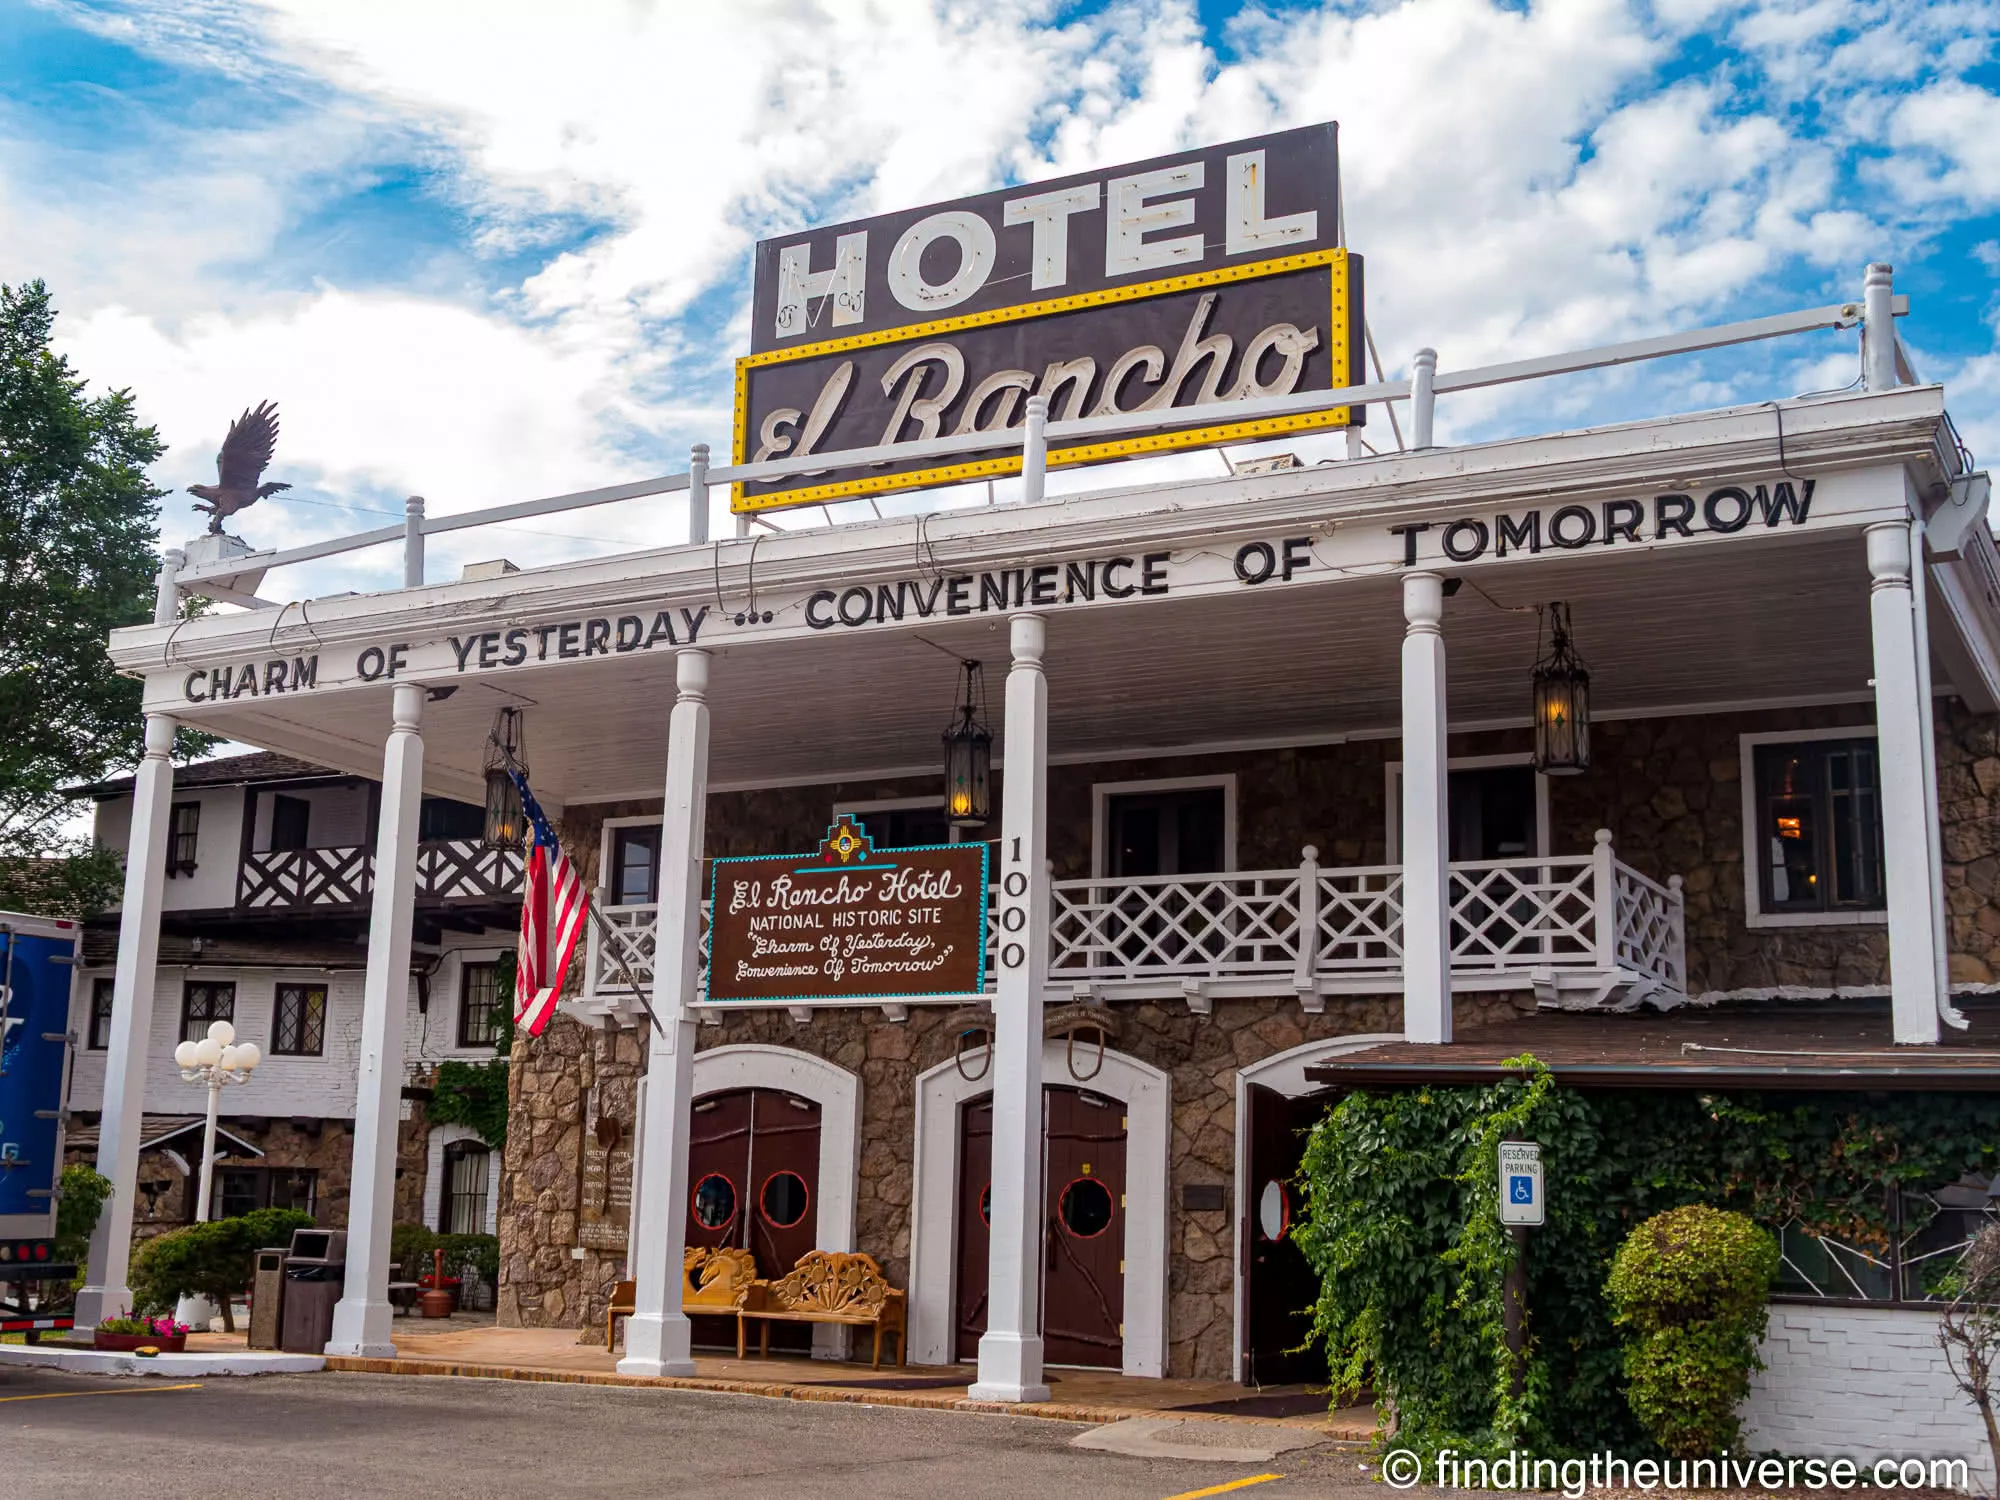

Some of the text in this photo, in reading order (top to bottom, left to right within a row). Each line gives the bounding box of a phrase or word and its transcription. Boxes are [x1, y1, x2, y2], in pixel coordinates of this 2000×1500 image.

[775, 149, 1318, 339] HOTEL
[752, 293, 1318, 482] El Rancho
[183, 654, 318, 703] CHARM
[357, 643, 409, 683] OF
[448, 605, 710, 673] YESTERDAY
[805, 551, 1172, 630] CONVENIENCE
[1233, 536, 1313, 585] OF
[1388, 479, 1817, 567] TOMORROW
[729, 867, 963, 915] El Rancho Hotel
[1001, 836, 1028, 969] 1000
[750, 907, 942, 931] NATIONAL HISTORIC SITE
[819, 933, 840, 958] Of
[843, 931, 936, 958] Yesterday,
[735, 959, 819, 982] Convenience
[823, 957, 845, 982] Of
[1505, 1163, 1538, 1174] PARKING
